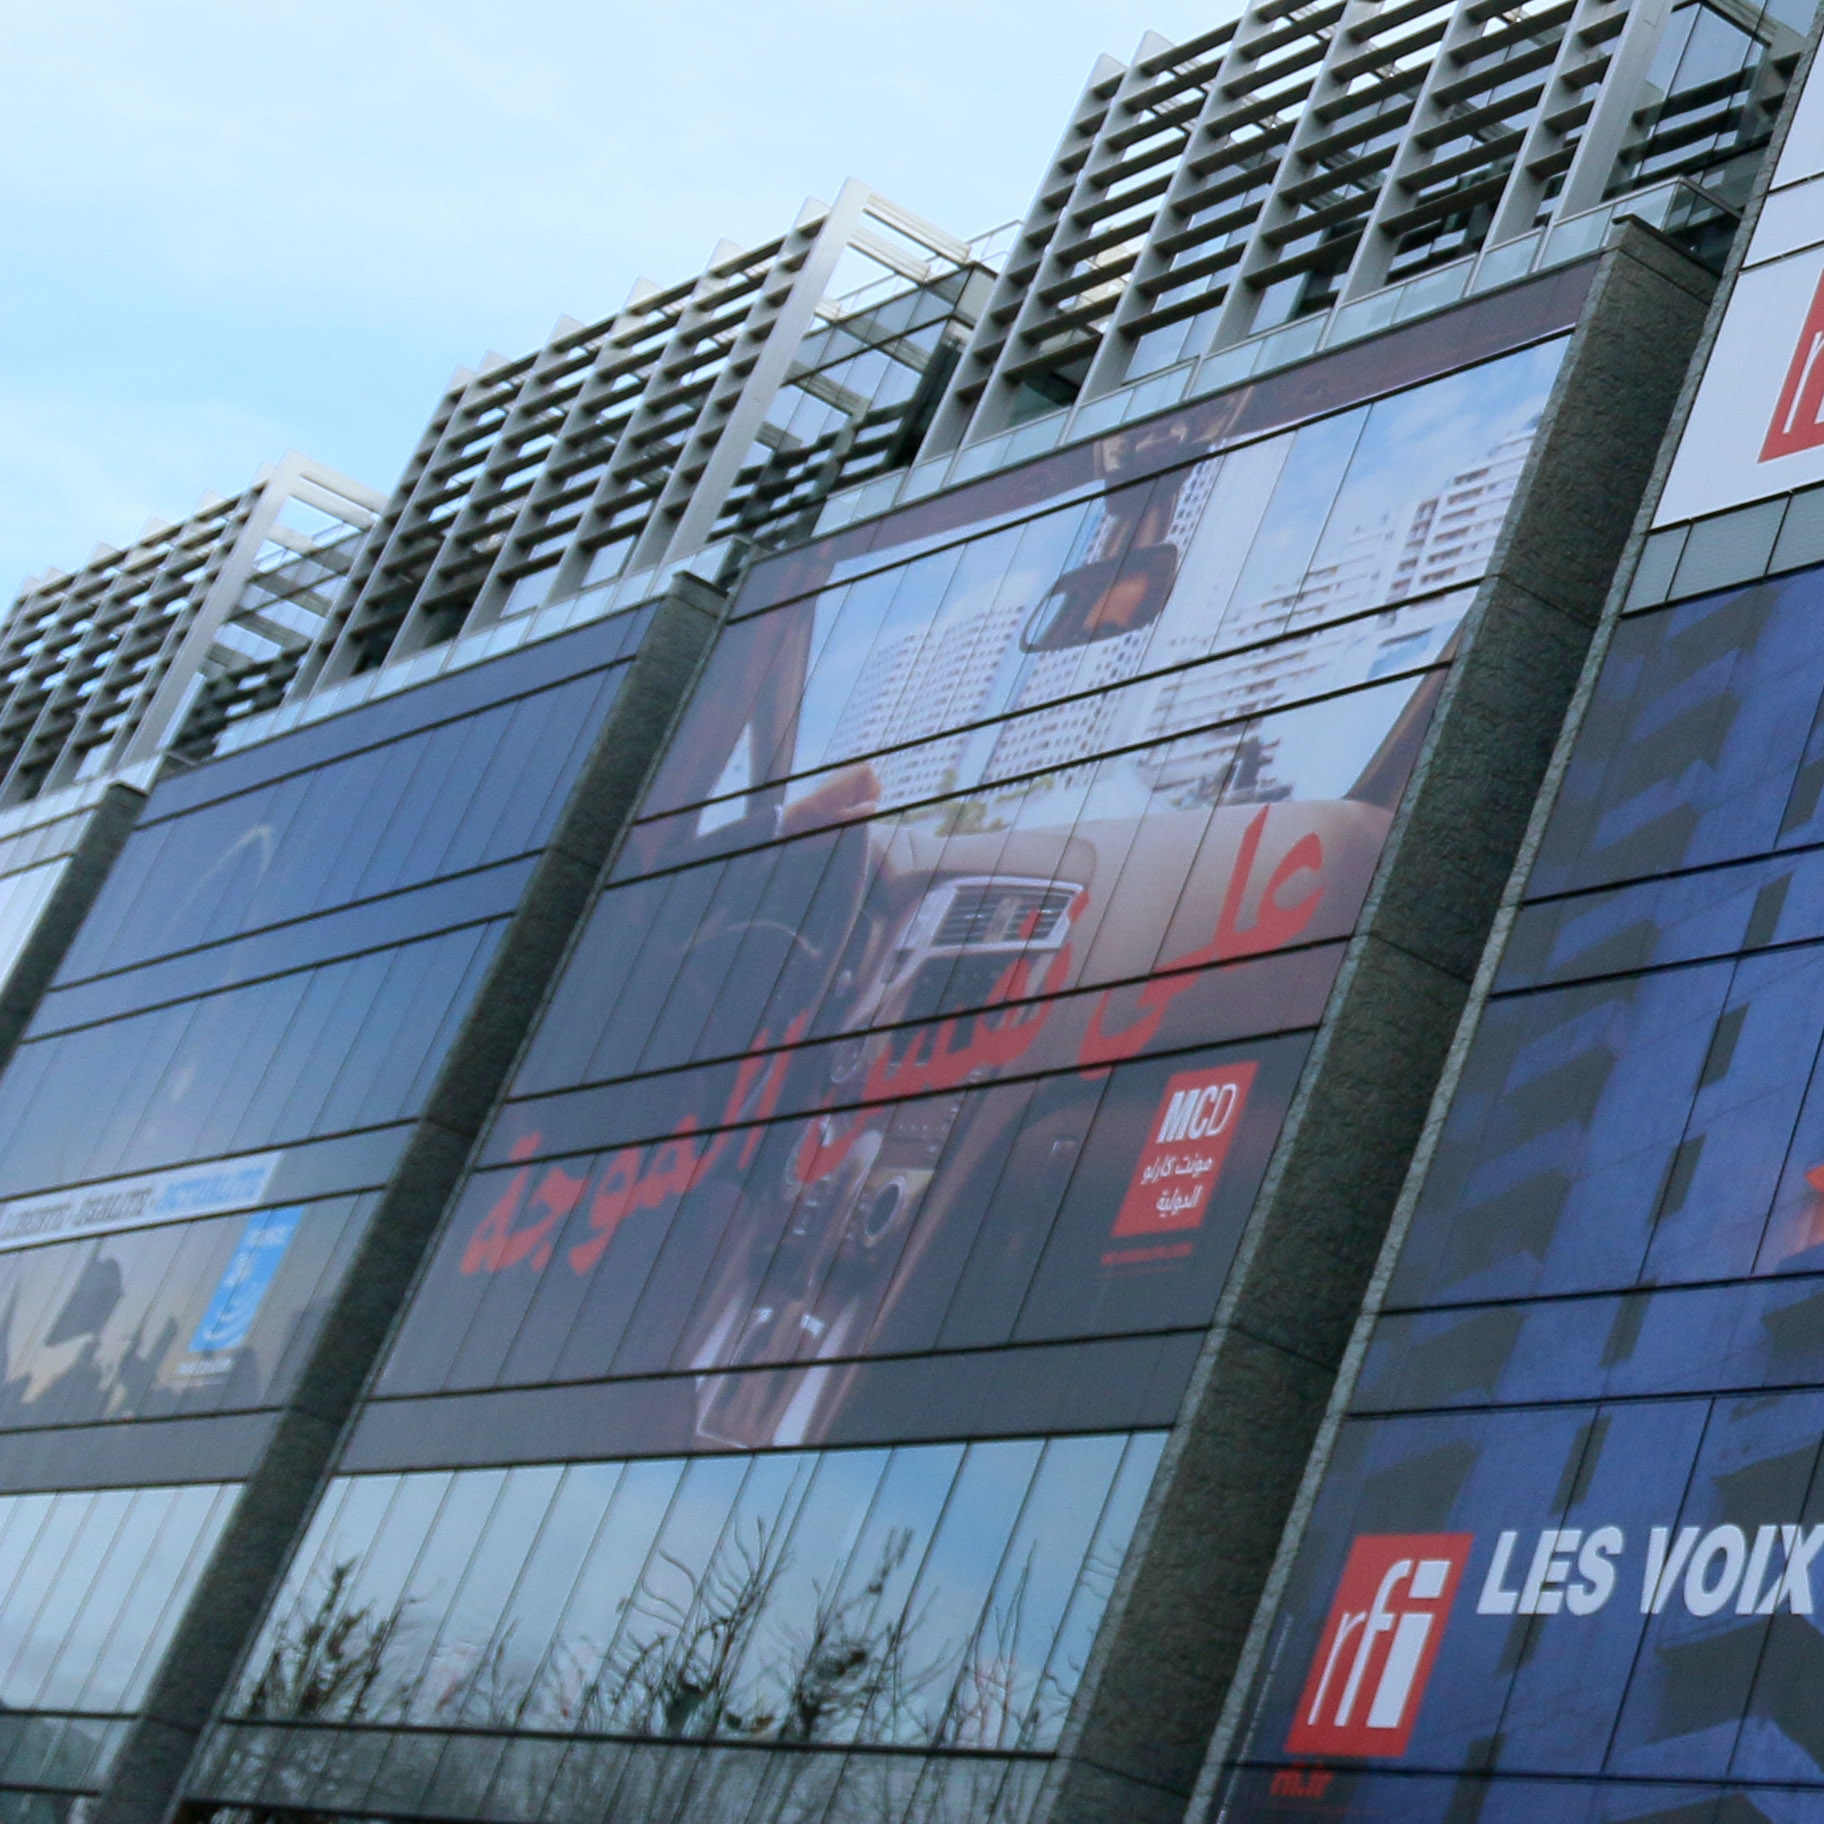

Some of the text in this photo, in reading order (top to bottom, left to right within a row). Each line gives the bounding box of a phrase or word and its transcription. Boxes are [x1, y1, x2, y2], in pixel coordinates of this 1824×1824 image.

[1078, 803, 1325, 1081] على
[1155, 1082, 1239, 1145] MCD
[1175, 1153, 1214, 1179] مونت
[1476, 1526, 1624, 1616] LES
[1307, 1559, 1451, 1728] rfi
